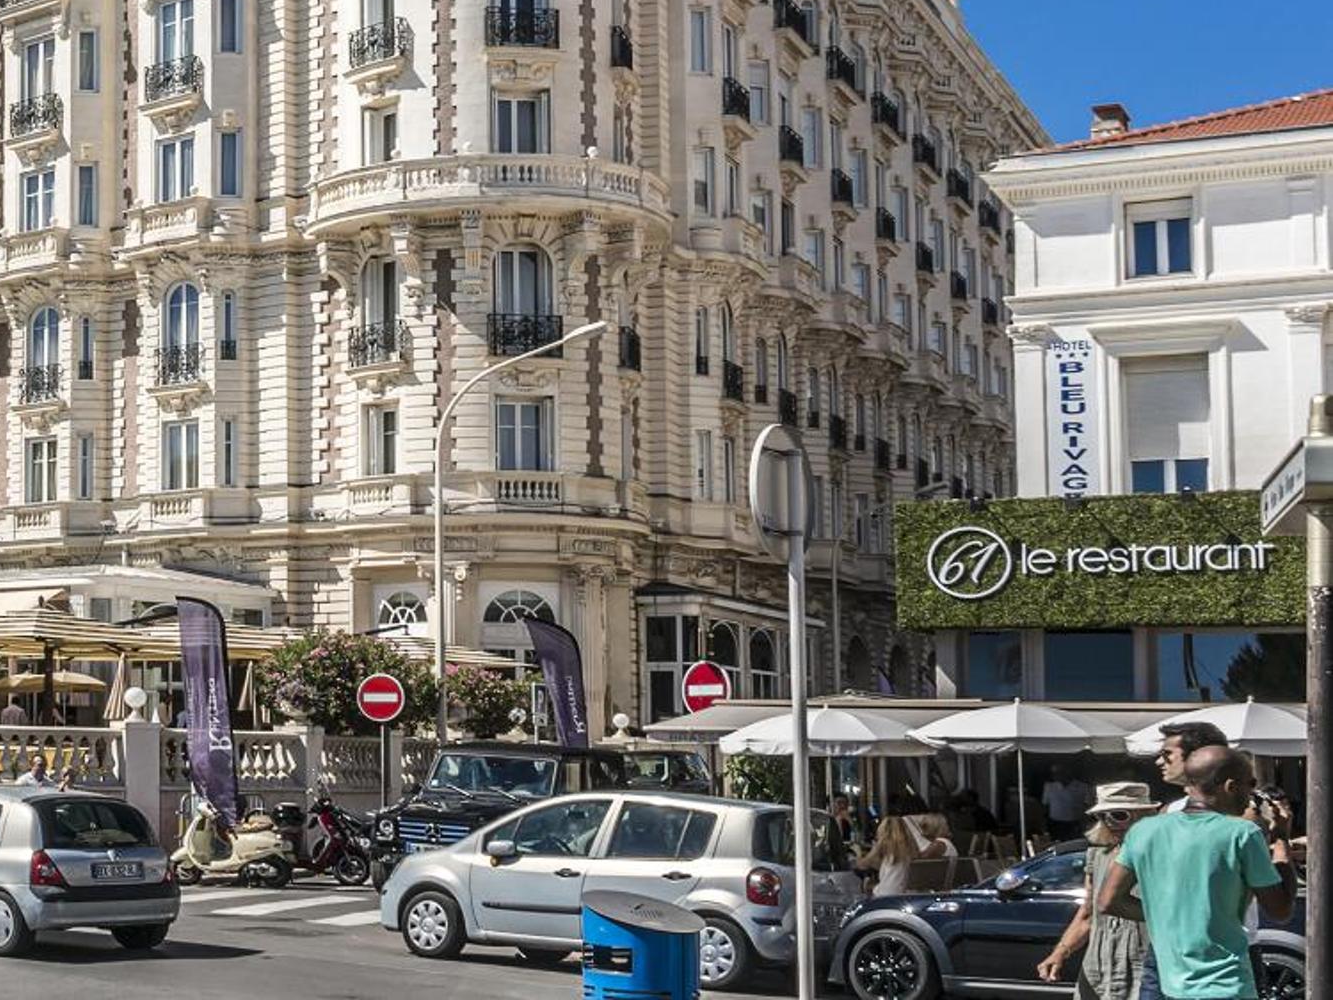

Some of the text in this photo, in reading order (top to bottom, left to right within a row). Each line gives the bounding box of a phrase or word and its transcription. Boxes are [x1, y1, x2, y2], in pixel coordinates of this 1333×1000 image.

[1053, 340, 1092, 352] HOTEL
[1059, 361, 1086, 415] BLEU
[938, 540, 1275, 585] 61 le restaurant
